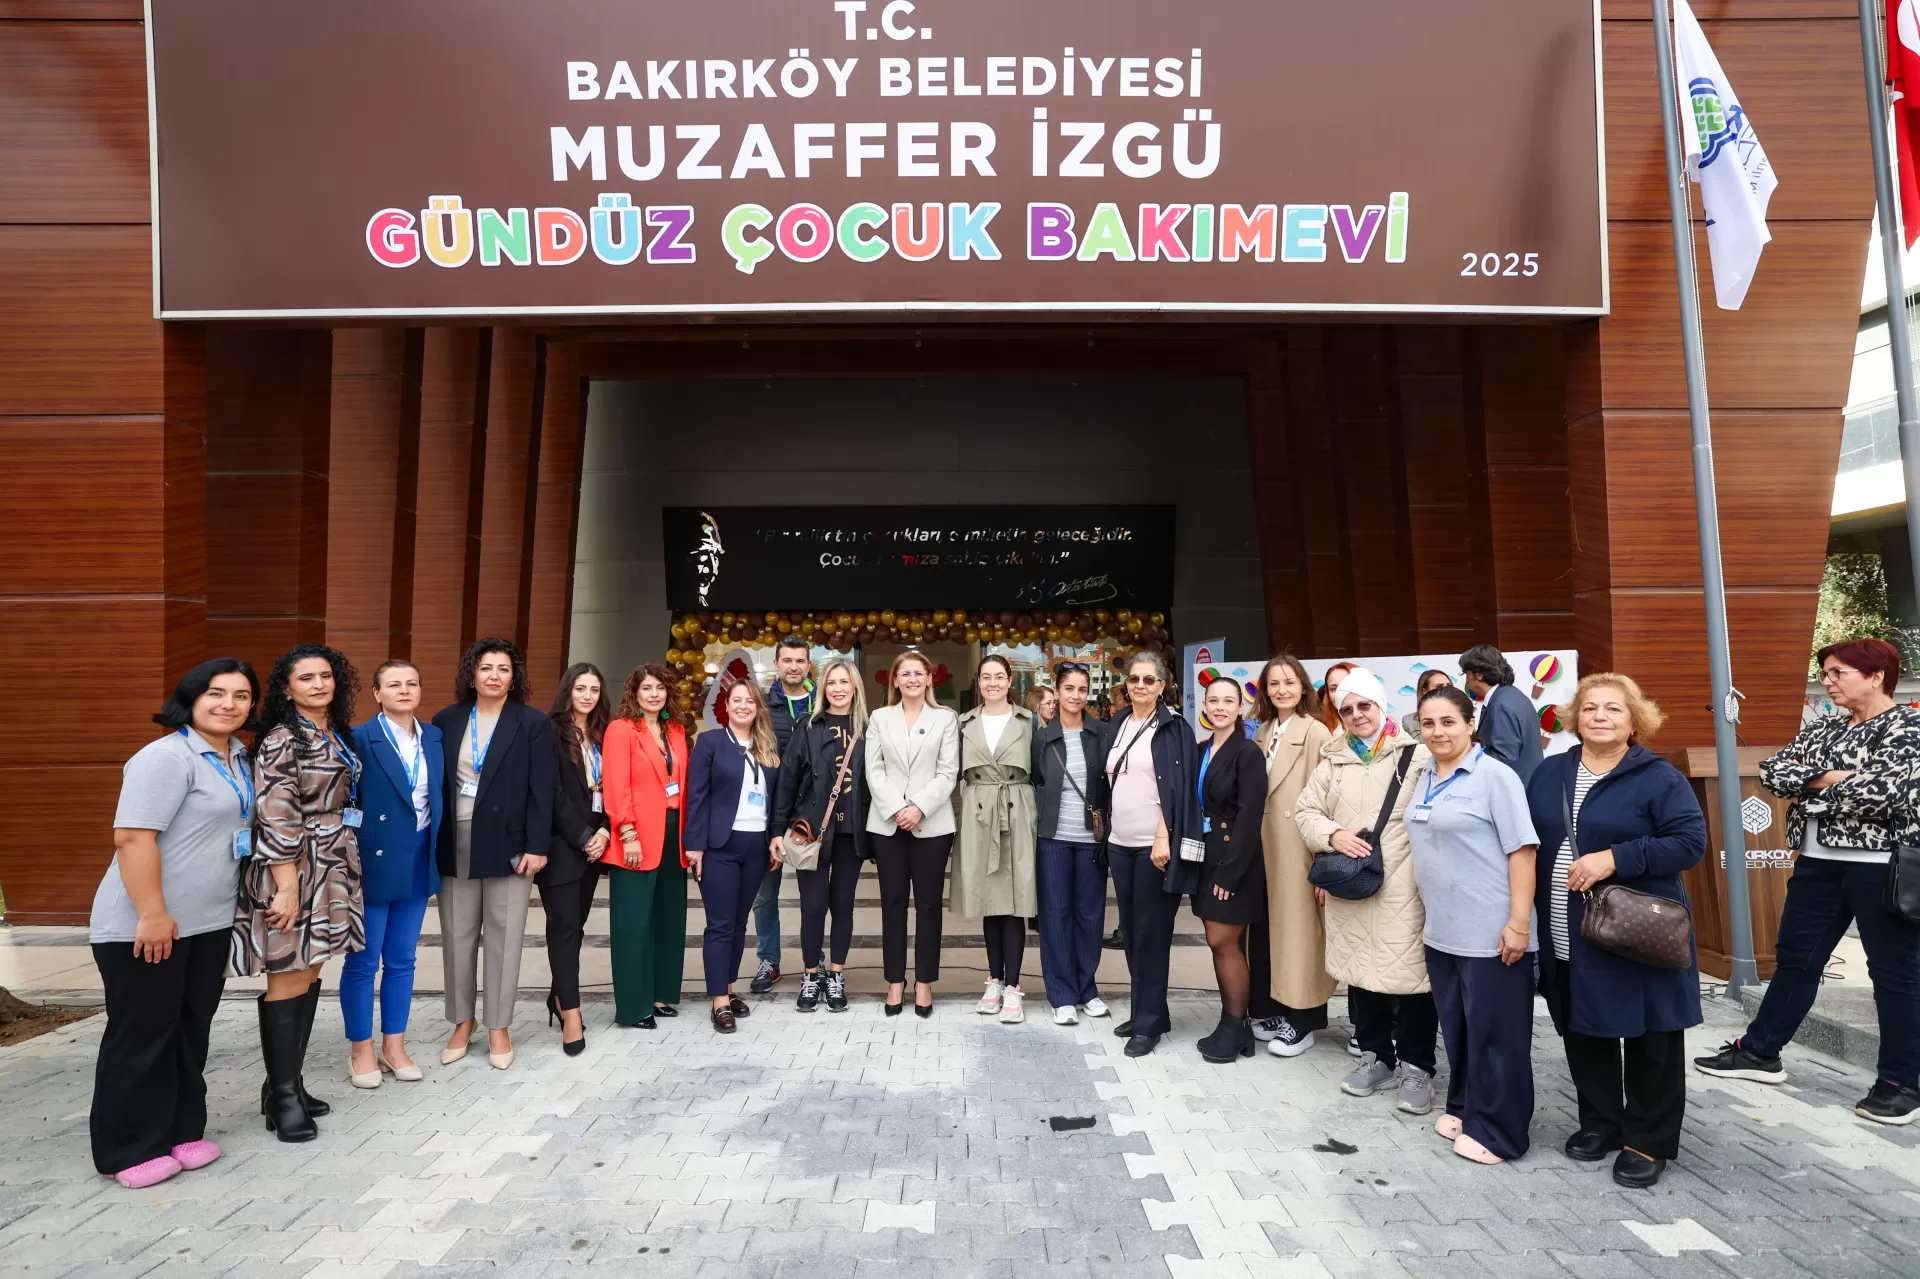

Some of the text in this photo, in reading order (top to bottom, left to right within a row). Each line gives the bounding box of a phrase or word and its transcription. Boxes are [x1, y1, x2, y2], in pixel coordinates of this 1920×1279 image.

[834, 0, 932, 41] T.C.
[566, 46, 1202, 101] BAKIRKÖY BELEDİYESİ
[550, 107, 1222, 182] MUZAFFER İZGÜ
[366, 192, 1409, 274] GÜNDÜZ ÇOCUK BAKIMEVİ
[1460, 252, 1539, 277] 2025
[1720, 849, 1794, 860] BKIRKÖY
